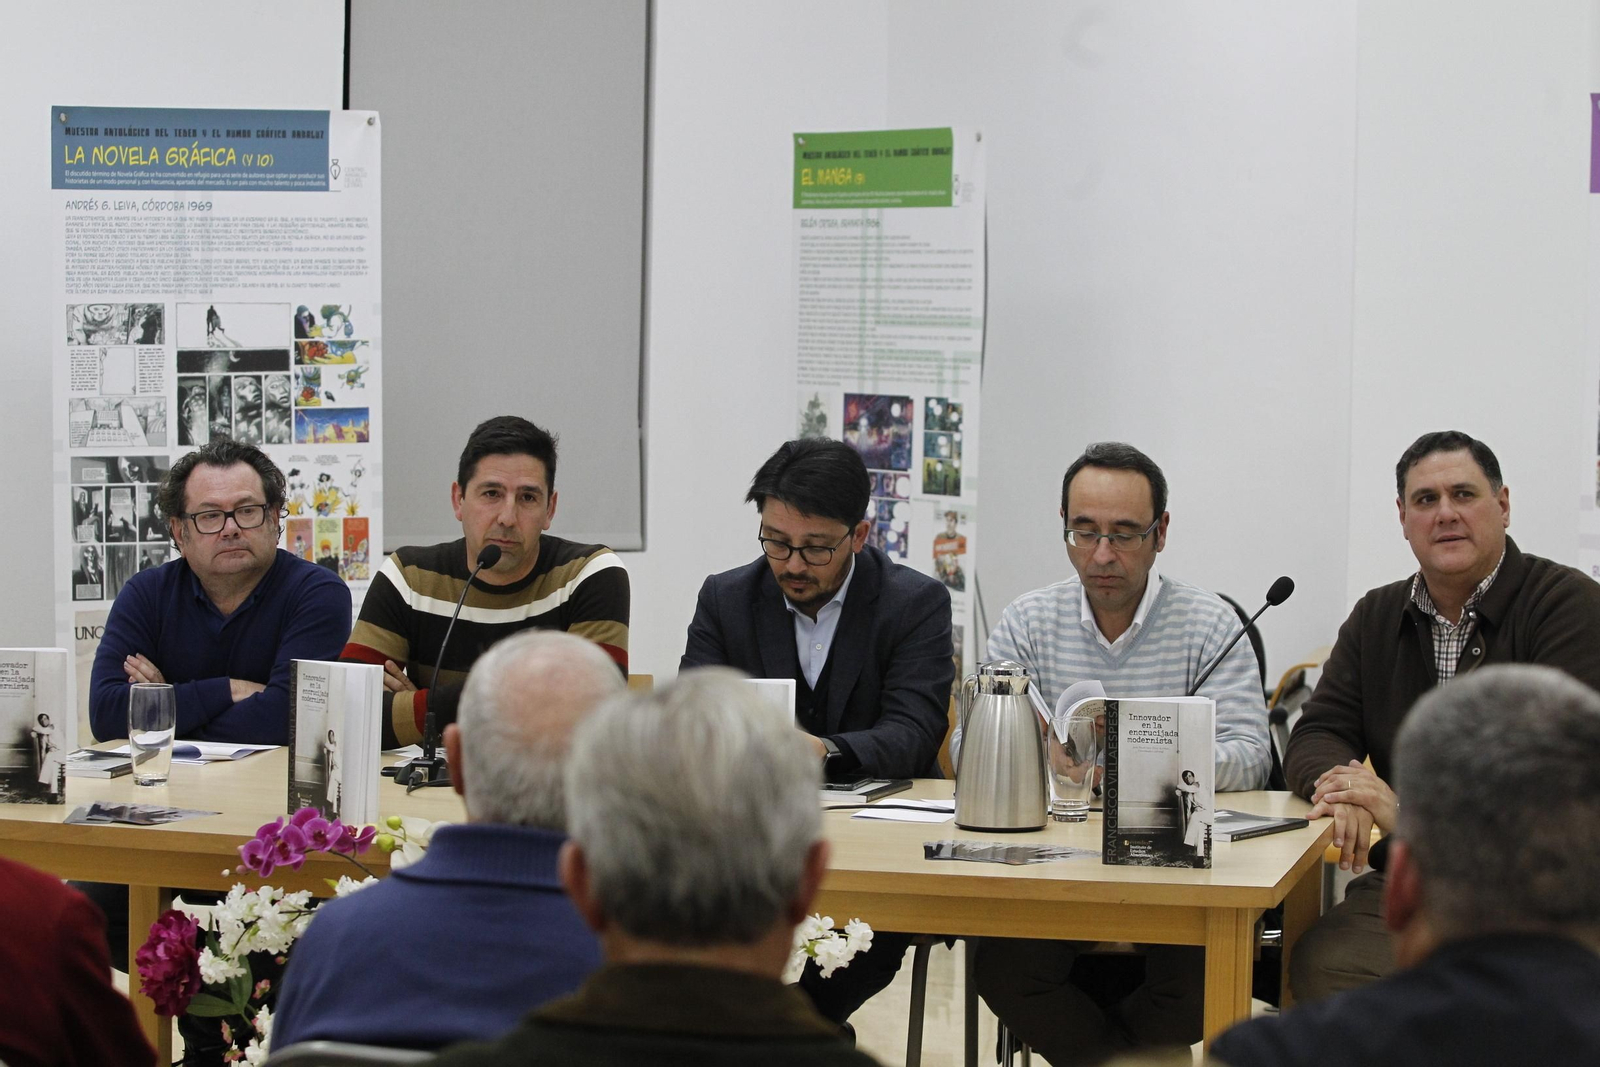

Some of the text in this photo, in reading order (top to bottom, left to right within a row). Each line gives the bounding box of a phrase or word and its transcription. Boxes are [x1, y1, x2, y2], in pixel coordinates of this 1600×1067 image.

[64, 145, 85, 165] LA
[92, 145, 159, 166] NOVELA
[166, 140, 236, 168] GRÁFICA
[242, 154, 253, 167] (Y
[802, 168, 815, 185] EL
[817, 167, 852, 185] MANGA
[65, 198, 98, 211] ANDRÉS
[114, 201, 139, 212] LEIVA,
[142, 198, 184, 212] CÓRDOBA
[188, 201, 213, 211] 1969
[1129, 713, 1171, 721] Innovador
[1108, 701, 1118, 786] VILLAESPESA
[1127, 736, 1173, 744] modernista
[1107, 788, 1117, 864] FRANCISCO
